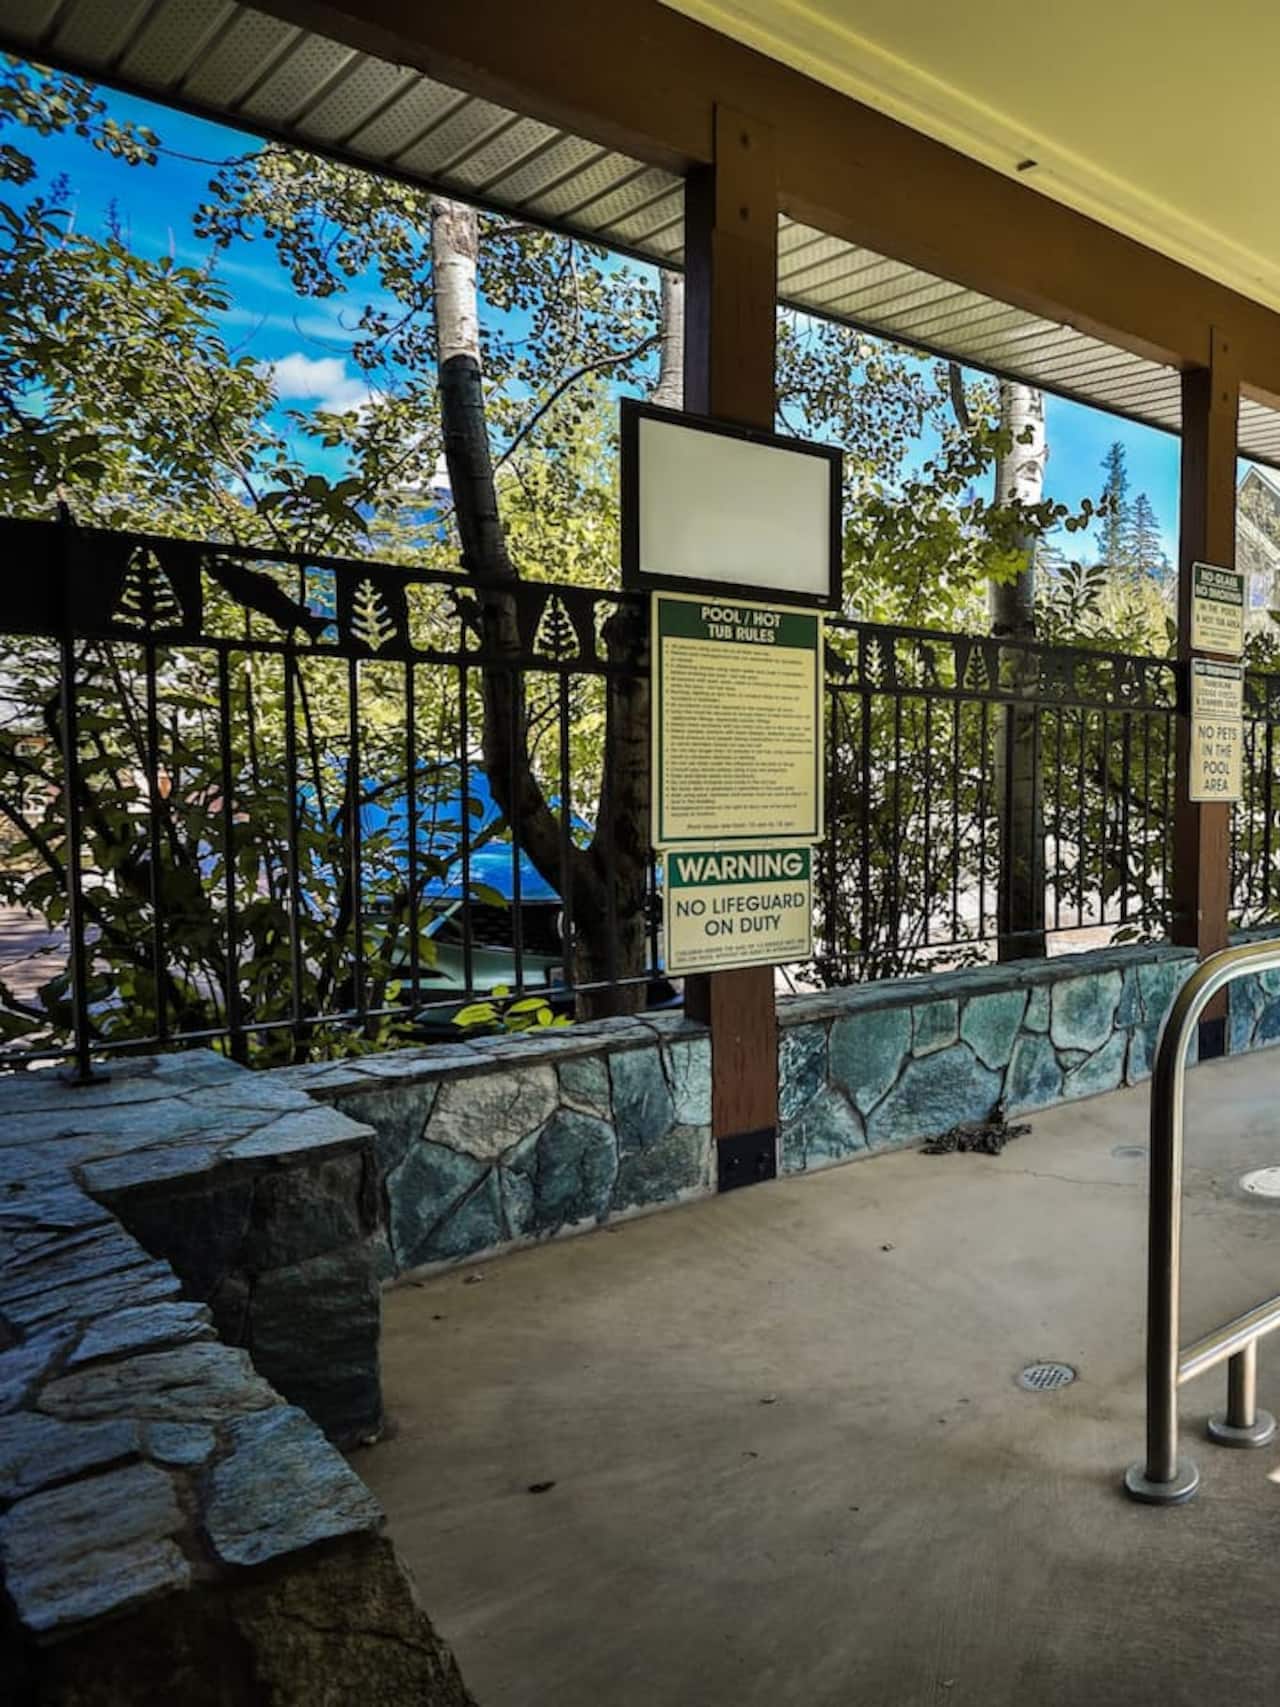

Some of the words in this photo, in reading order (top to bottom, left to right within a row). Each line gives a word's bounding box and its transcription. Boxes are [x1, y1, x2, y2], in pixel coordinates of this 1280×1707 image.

[1200, 568, 1213, 582] NO
[1196, 583, 1208, 597] NO
[701, 606, 741, 624] POOL
[743, 609, 750, 625] /
[752, 611, 782, 627] HOT
[708, 624, 733, 639] TUB
[735, 627, 775, 643] RULES
[1199, 725, 1214, 739] NO
[1216, 726, 1237, 740] PETS
[1201, 743, 1213, 756] IN
[1215, 744, 1232, 757] THE
[1203, 760, 1230, 775] POOL
[1204, 778, 1229, 792] AREA
[676, 853, 804, 883] WARNING
[676, 899, 706, 917] NO
[713, 892, 805, 914] LIFEGUARD
[704, 918, 733, 936] ON
[740, 915, 782, 933] DUTY
